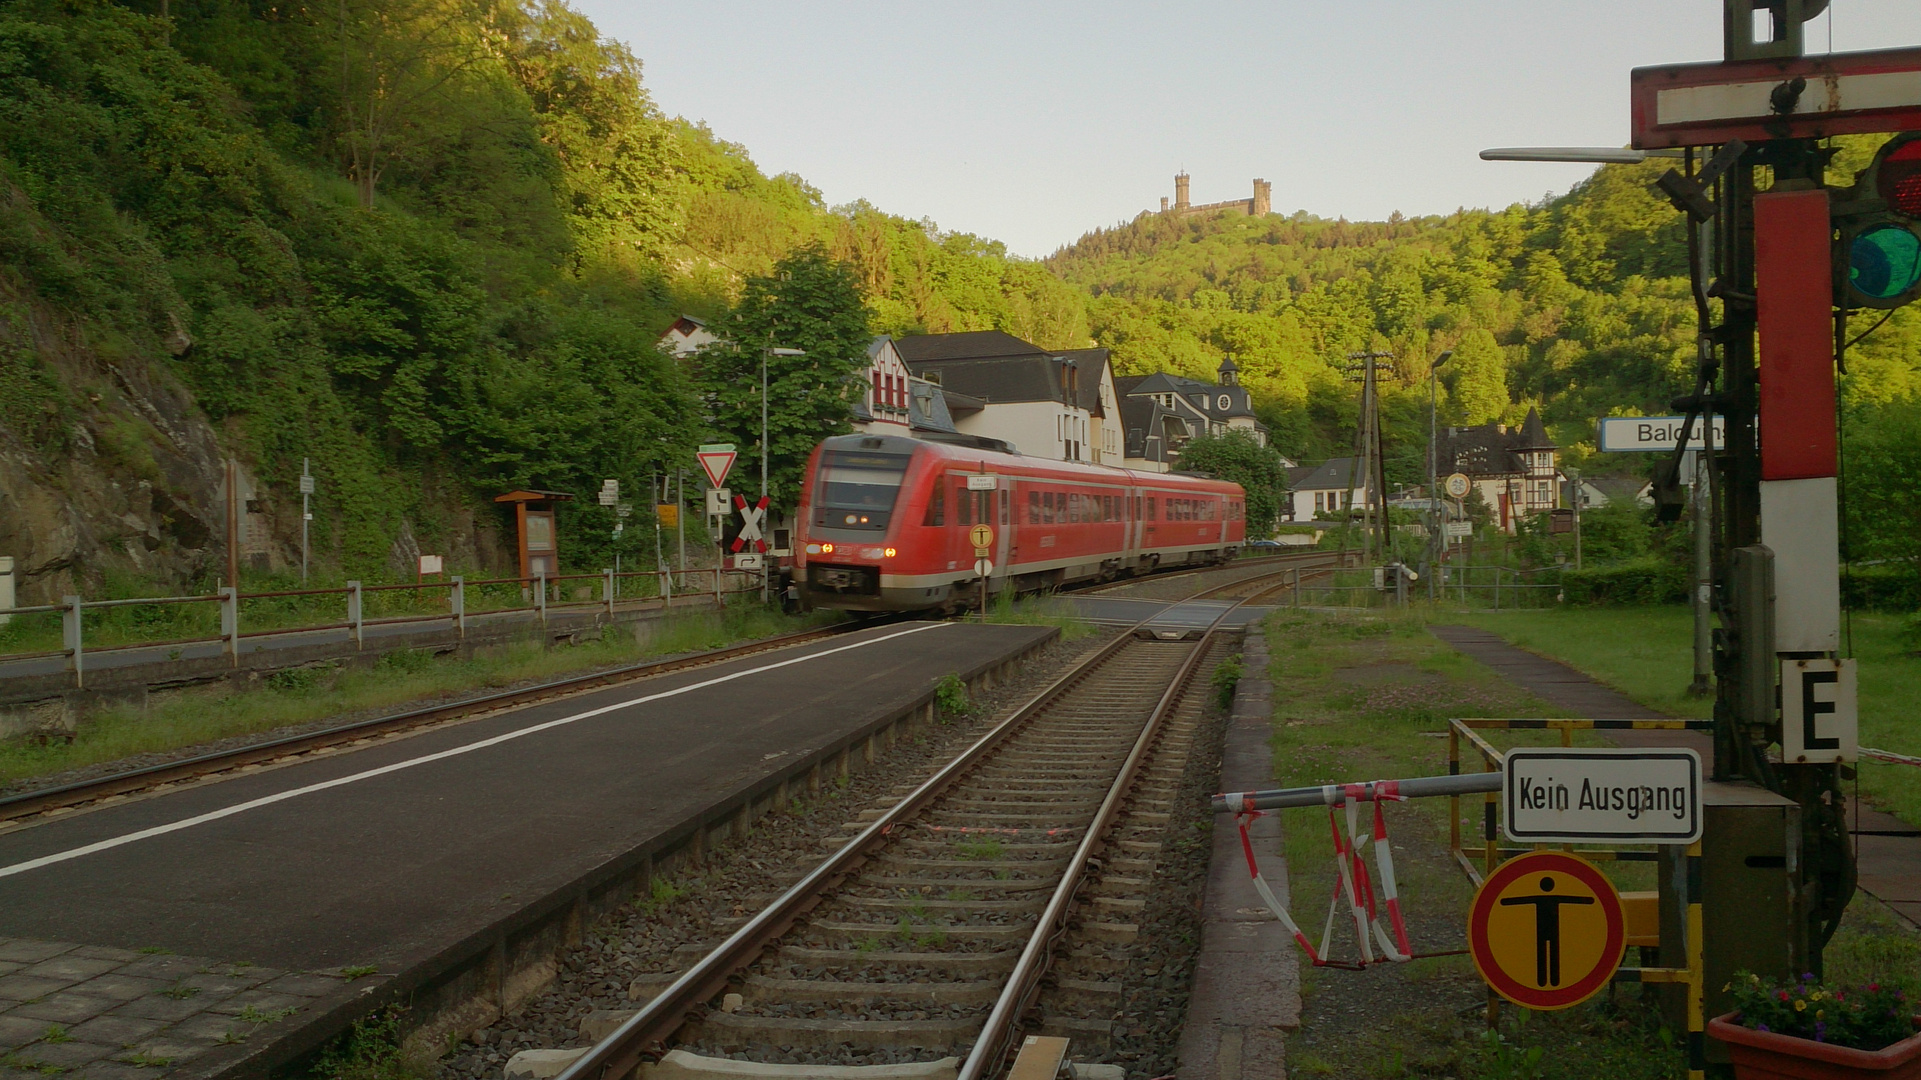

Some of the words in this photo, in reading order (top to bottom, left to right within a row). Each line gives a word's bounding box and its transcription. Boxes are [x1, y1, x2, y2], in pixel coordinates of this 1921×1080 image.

[1802, 671, 1840, 750] E
[1520, 777, 1569, 810] Kein
[1578, 777, 1686, 820] Ausgang
